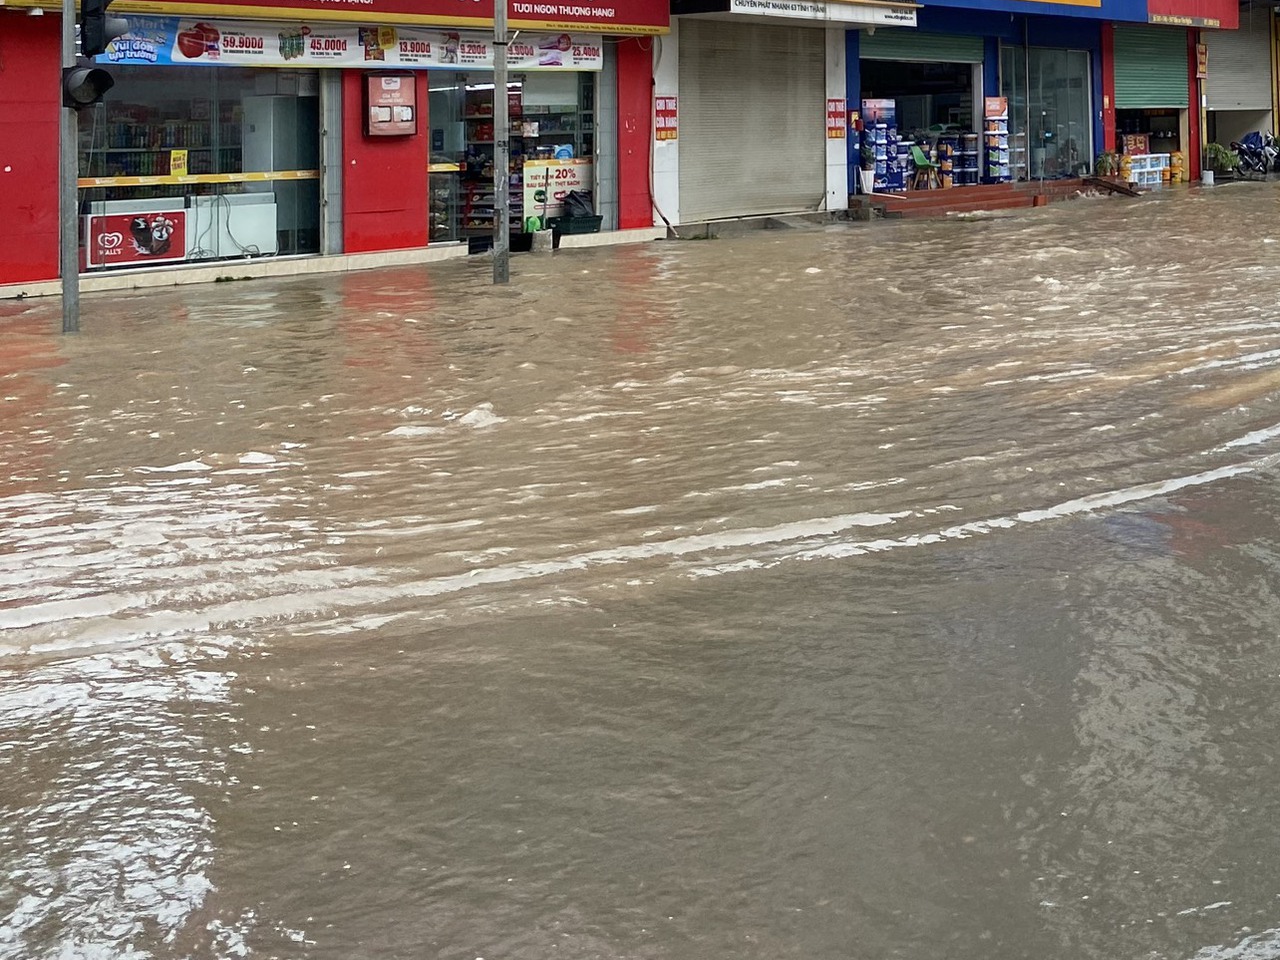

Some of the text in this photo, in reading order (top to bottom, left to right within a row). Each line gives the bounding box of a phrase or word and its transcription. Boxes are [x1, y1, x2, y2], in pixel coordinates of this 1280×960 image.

[533, 4, 558, 15] NGON
[757, 1, 770, 9] PHÁT
[771, 2, 791, 11] NHANH
[555, 168, 576, 179] 20%
